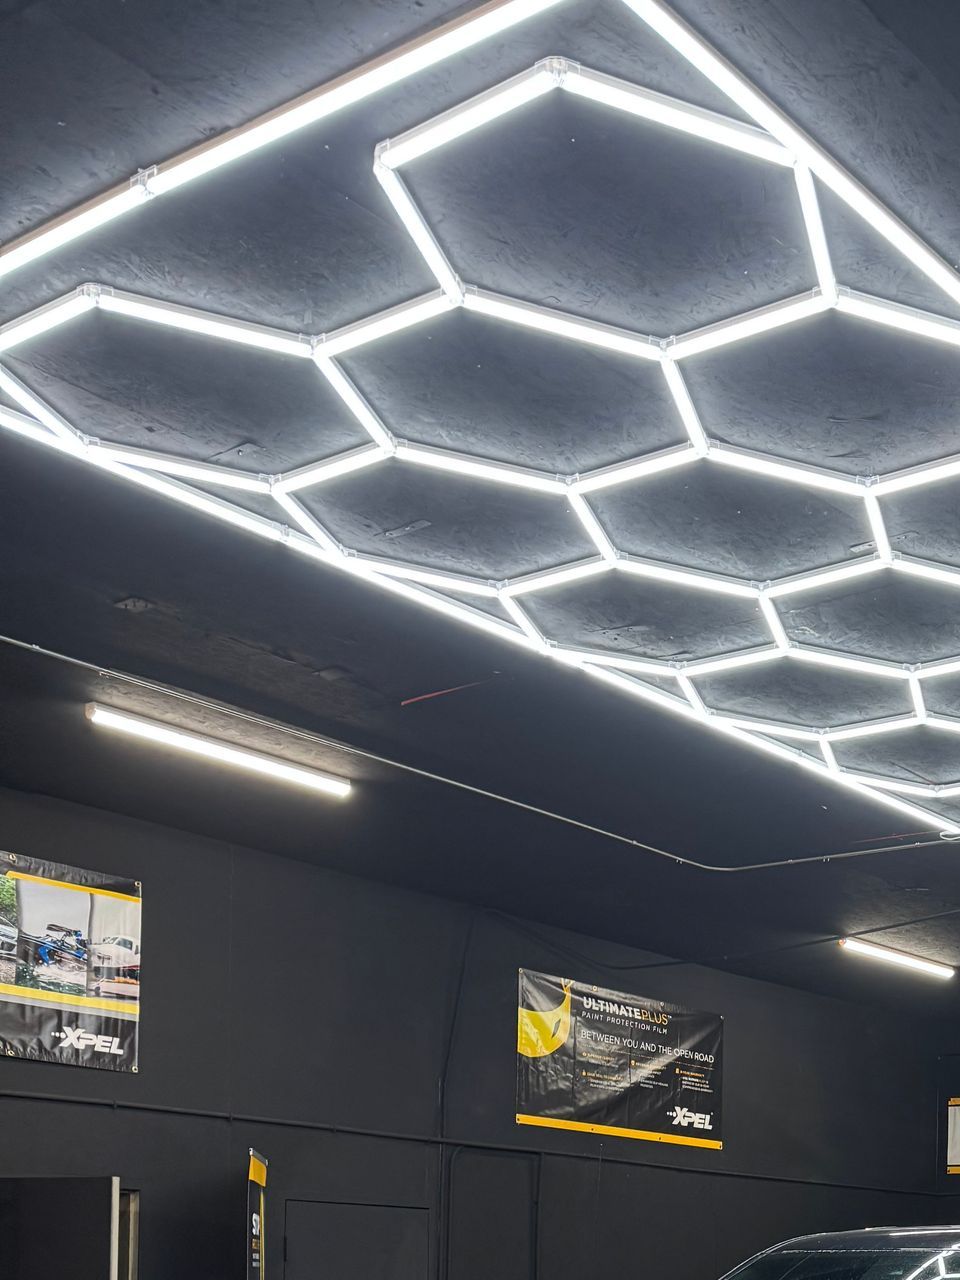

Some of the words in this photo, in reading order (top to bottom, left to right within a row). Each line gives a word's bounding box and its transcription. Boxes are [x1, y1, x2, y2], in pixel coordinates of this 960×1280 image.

[582, 1010, 604, 1021] PAINT
[606, 1016, 651, 1031] PROTECTION
[653, 1025, 668, 1035] FILM
[58, 1026, 124, 1055] XPEL
[581, 1029, 621, 1045] BETWEEN
[622, 1038, 639, 1049] YOU
[640, 1042, 657, 1053] AND
[658, 1045, 673, 1056] THE
[673, 1048, 694, 1060] OPEN
[694, 1052, 715, 1064] ROAD
[671, 1106, 713, 1130] XPEL
